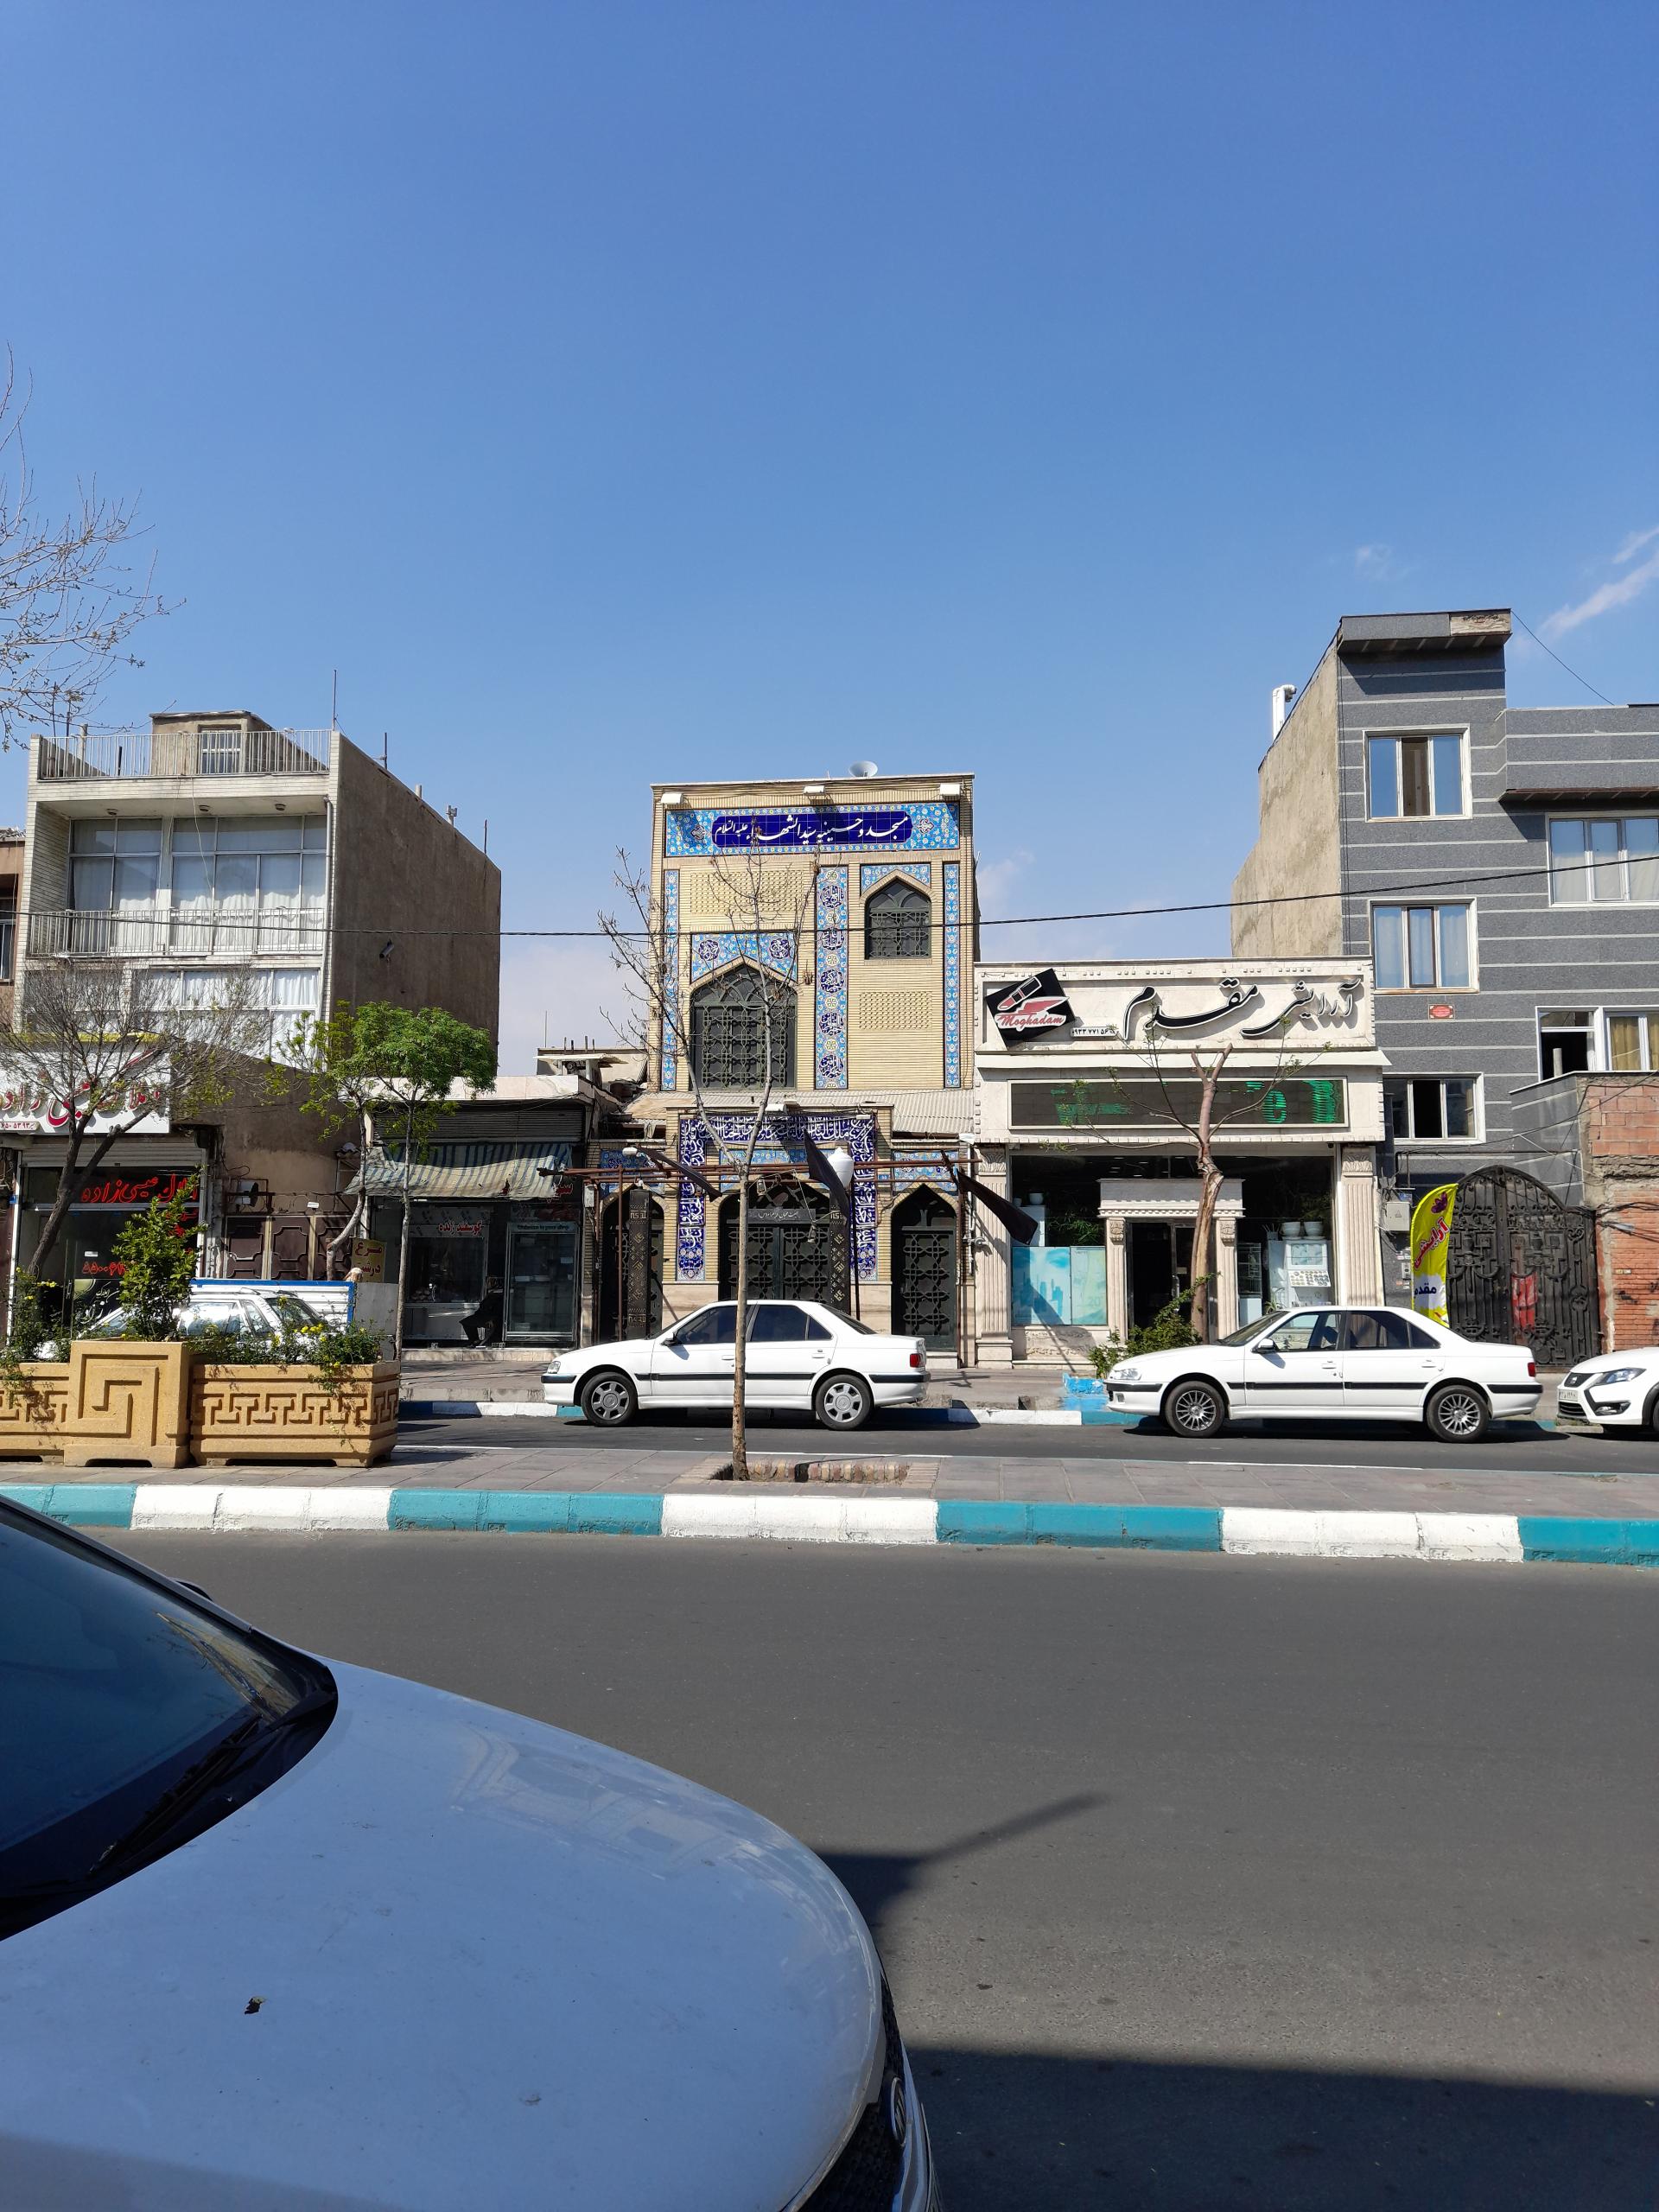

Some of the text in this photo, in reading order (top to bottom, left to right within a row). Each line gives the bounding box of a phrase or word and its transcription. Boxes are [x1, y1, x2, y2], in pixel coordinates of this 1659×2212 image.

[866, 817, 908, 840] مسجد
[1122, 977, 1362, 1040] آرایش مقدم
[996, 1014, 1064, 1030] Moghadam
[81, 1179, 123, 1204] زاده
